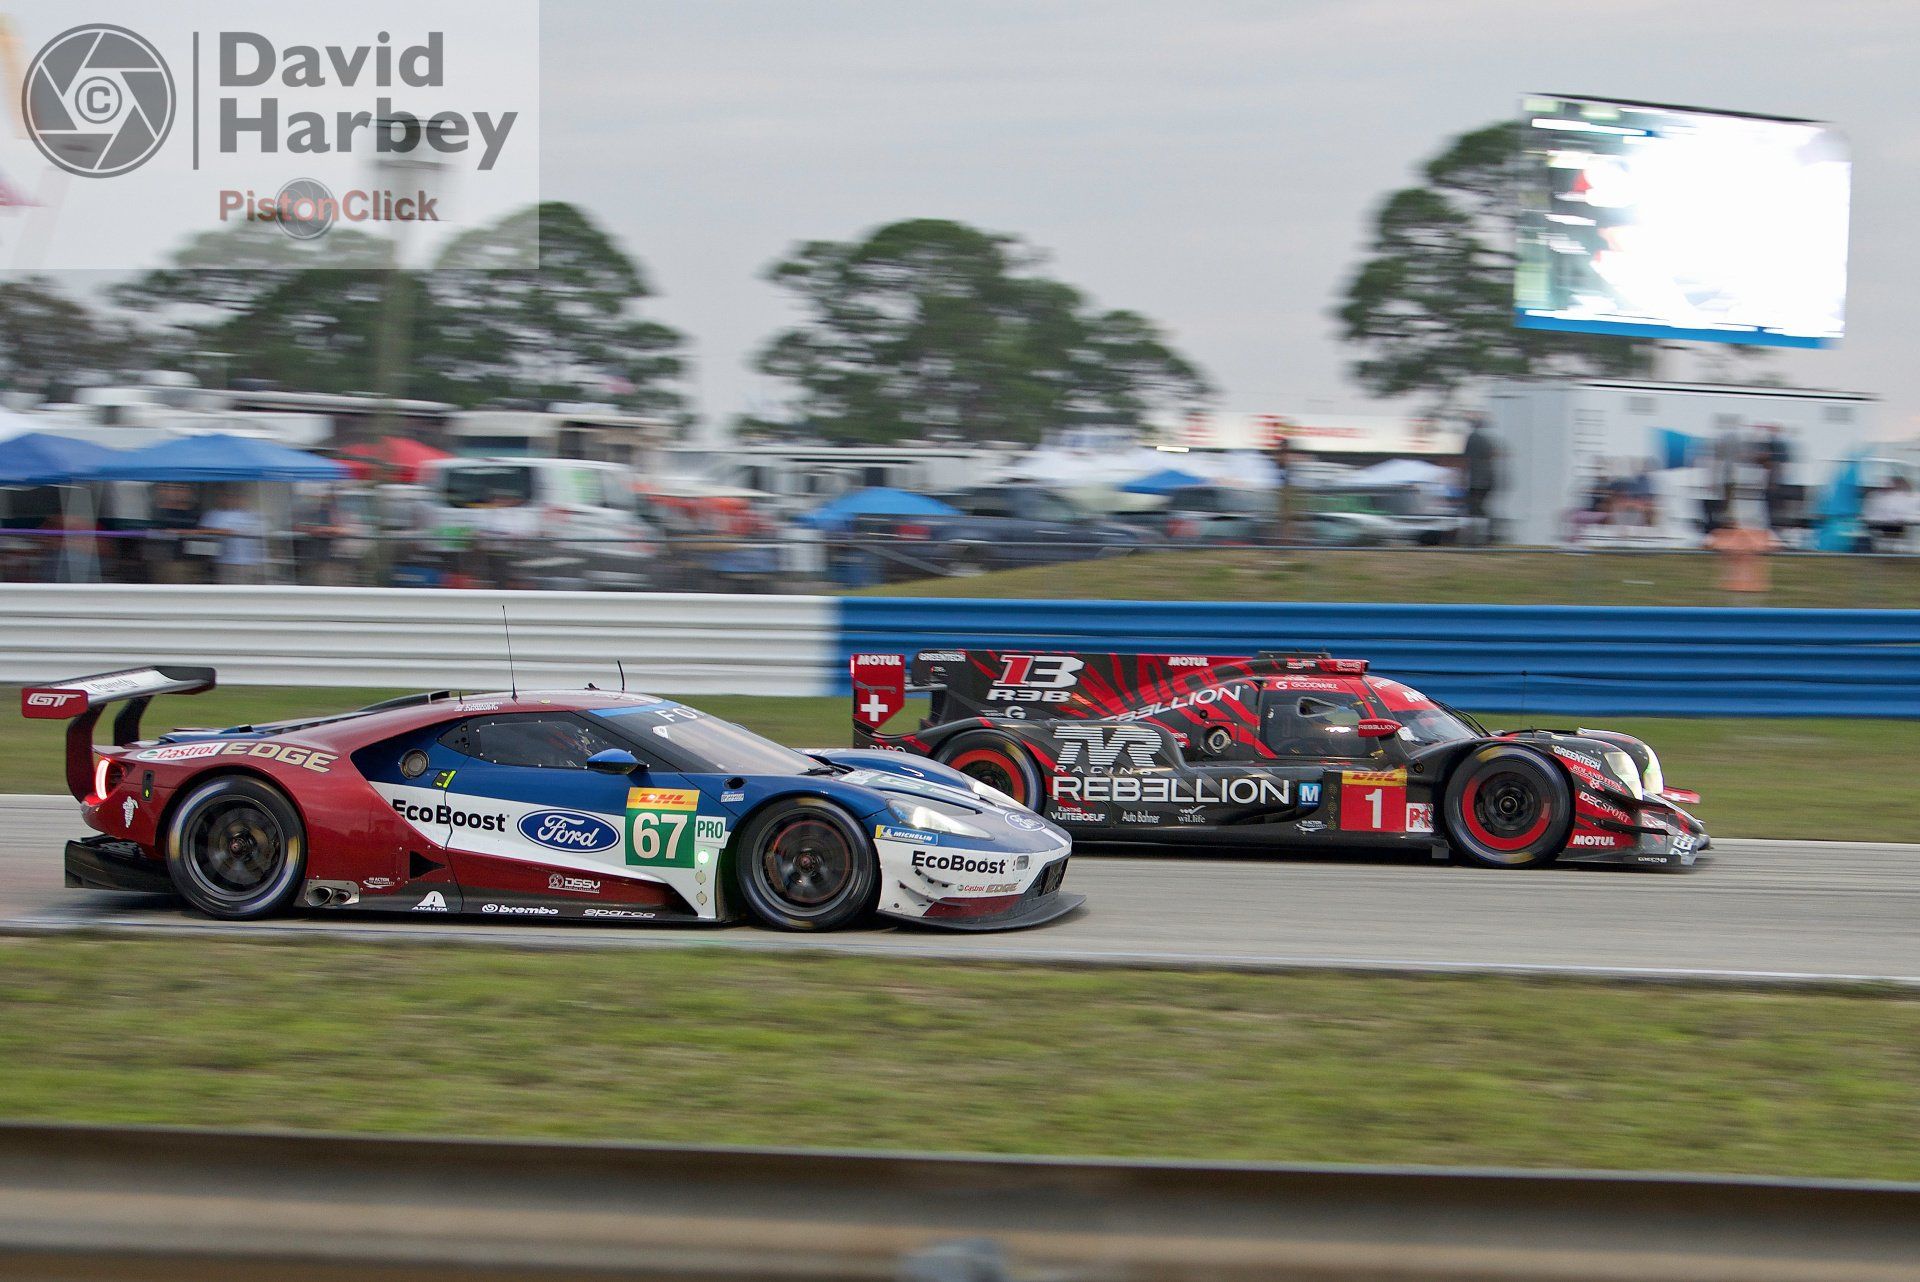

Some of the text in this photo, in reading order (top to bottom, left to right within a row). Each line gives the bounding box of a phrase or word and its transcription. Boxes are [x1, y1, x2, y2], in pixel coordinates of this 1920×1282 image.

[856, 655, 901, 666] MOTUL
[1168, 656, 1209, 667] MOTUL
[27, 693, 80, 707] GT
[158, 742, 339, 773] Castrol EDGE
[1553, 745, 1602, 770] GREENTECH
[638, 793, 686, 805] DHL
[1052, 776, 1290, 804] REBELLION
[392, 799, 506, 832] EcoBoost
[1364, 788, 1383, 829] 1
[1579, 791, 1630, 824] IDEC SPORT
[537, 814, 598, 847] Ford
[632, 812, 688, 860] 67
[697, 820, 724, 838] PRO
[893, 831, 933, 843] MICHELIN
[1573, 834, 1615, 846] MOTUL
[911, 850, 1006, 875] EcoBoost
[963, 883, 1020, 893] Castrol EDGE
[498, 905, 559, 915] brembo
[582, 909, 656, 919] sparco
